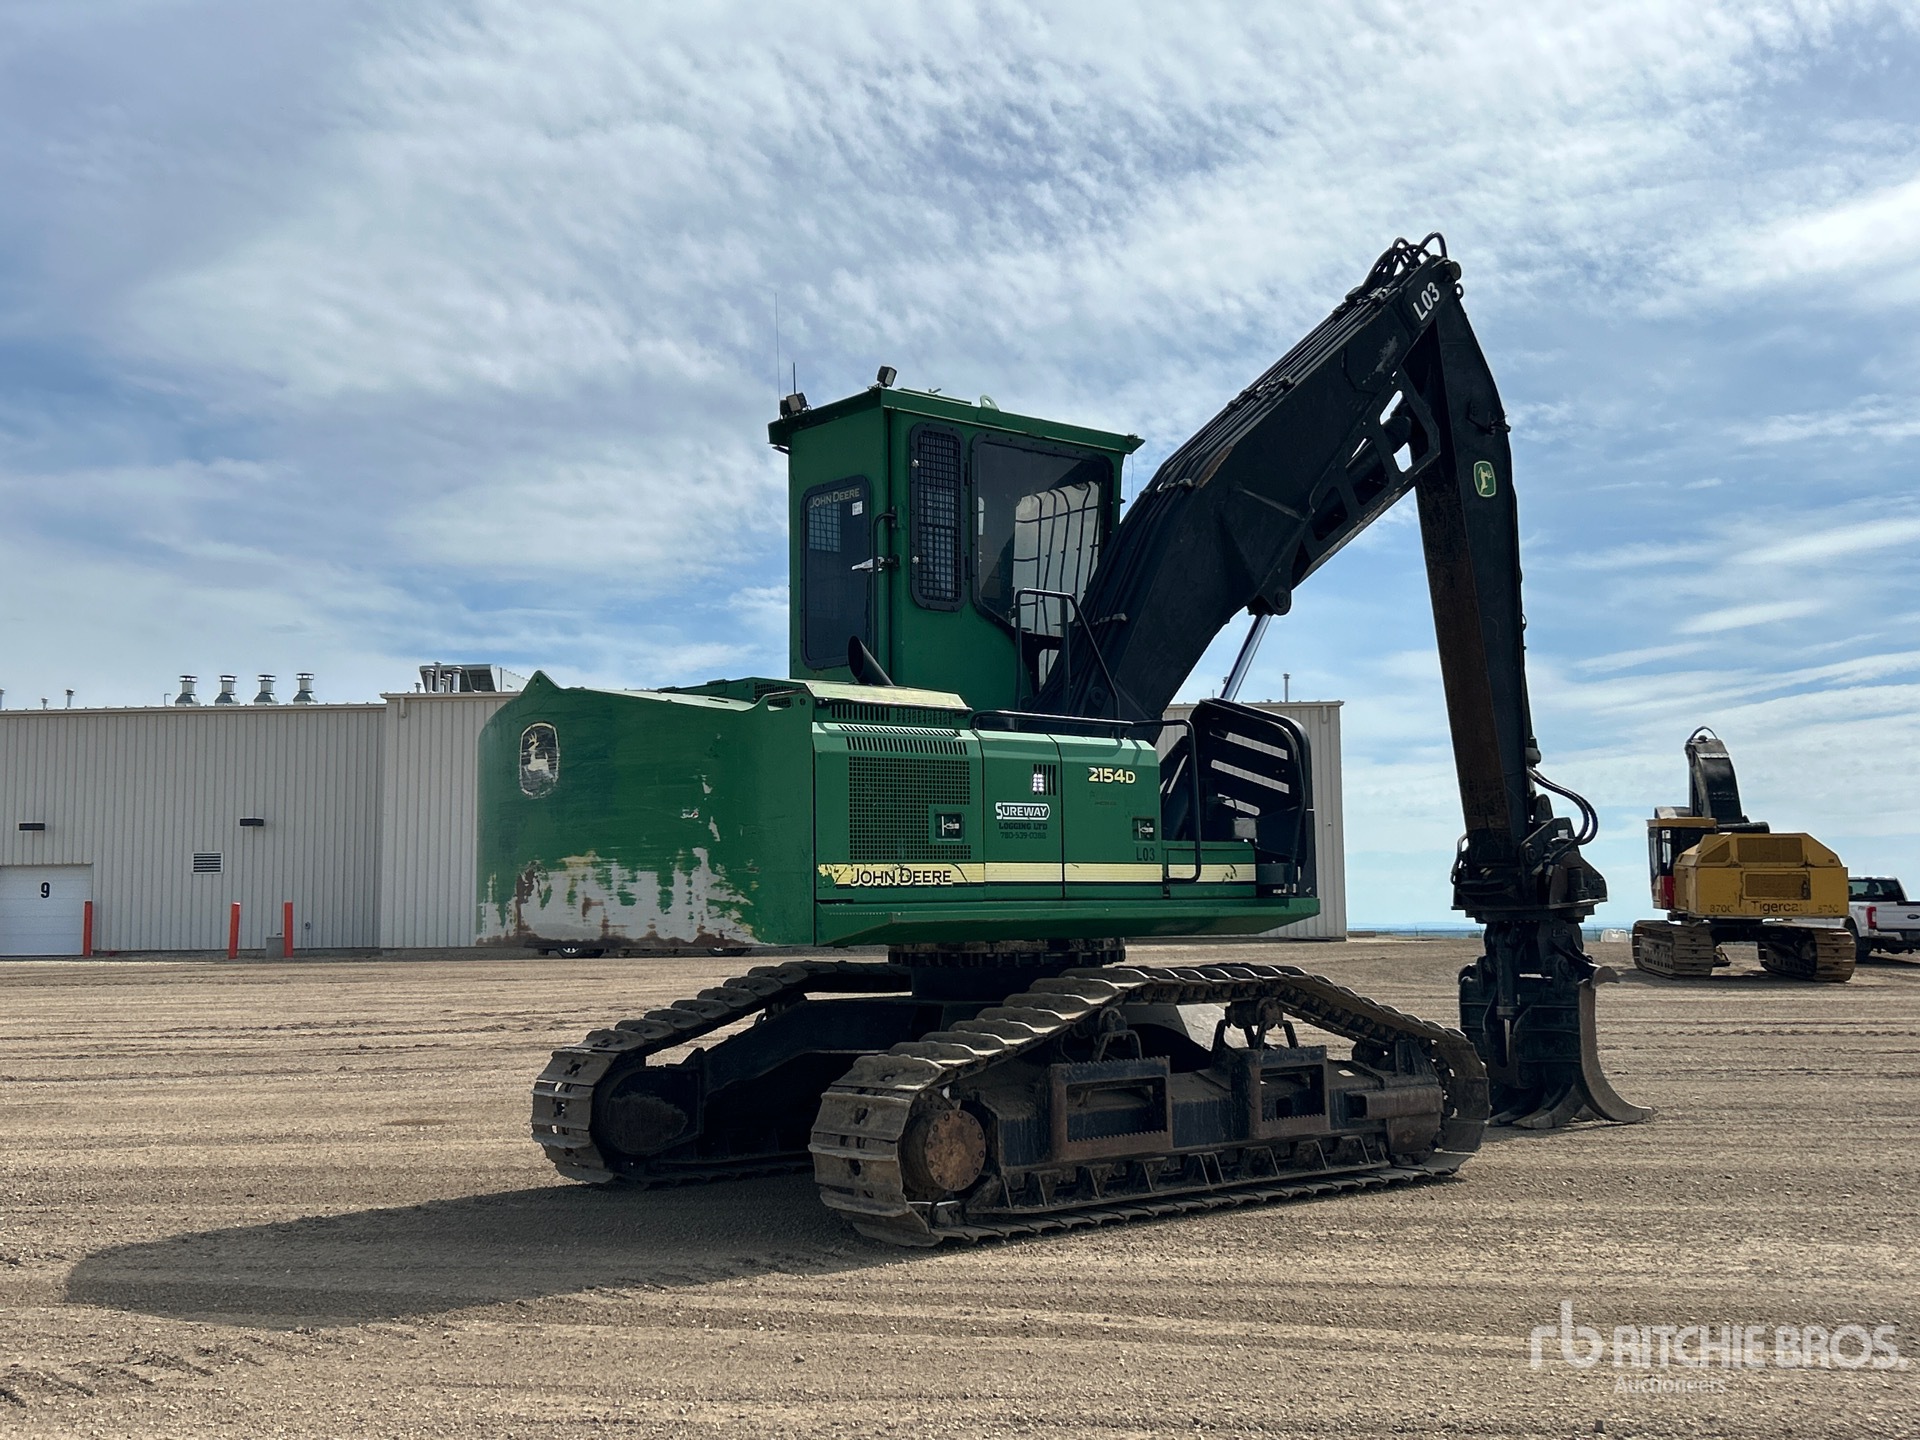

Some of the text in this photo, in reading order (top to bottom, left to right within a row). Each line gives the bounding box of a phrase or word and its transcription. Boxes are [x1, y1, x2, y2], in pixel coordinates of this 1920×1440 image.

[1412, 281, 1440, 321] L03
[810, 488, 860, 508] JOHN DEERE
[1088, 767, 1136, 784] 2154D
[995, 802, 1048, 820] SUREWAY
[999, 822, 1048, 831] LOGGING LTD
[1136, 847, 1155, 861] L03
[851, 868, 953, 884] JOHN DEERE
[40, 882, 50, 898] 9
